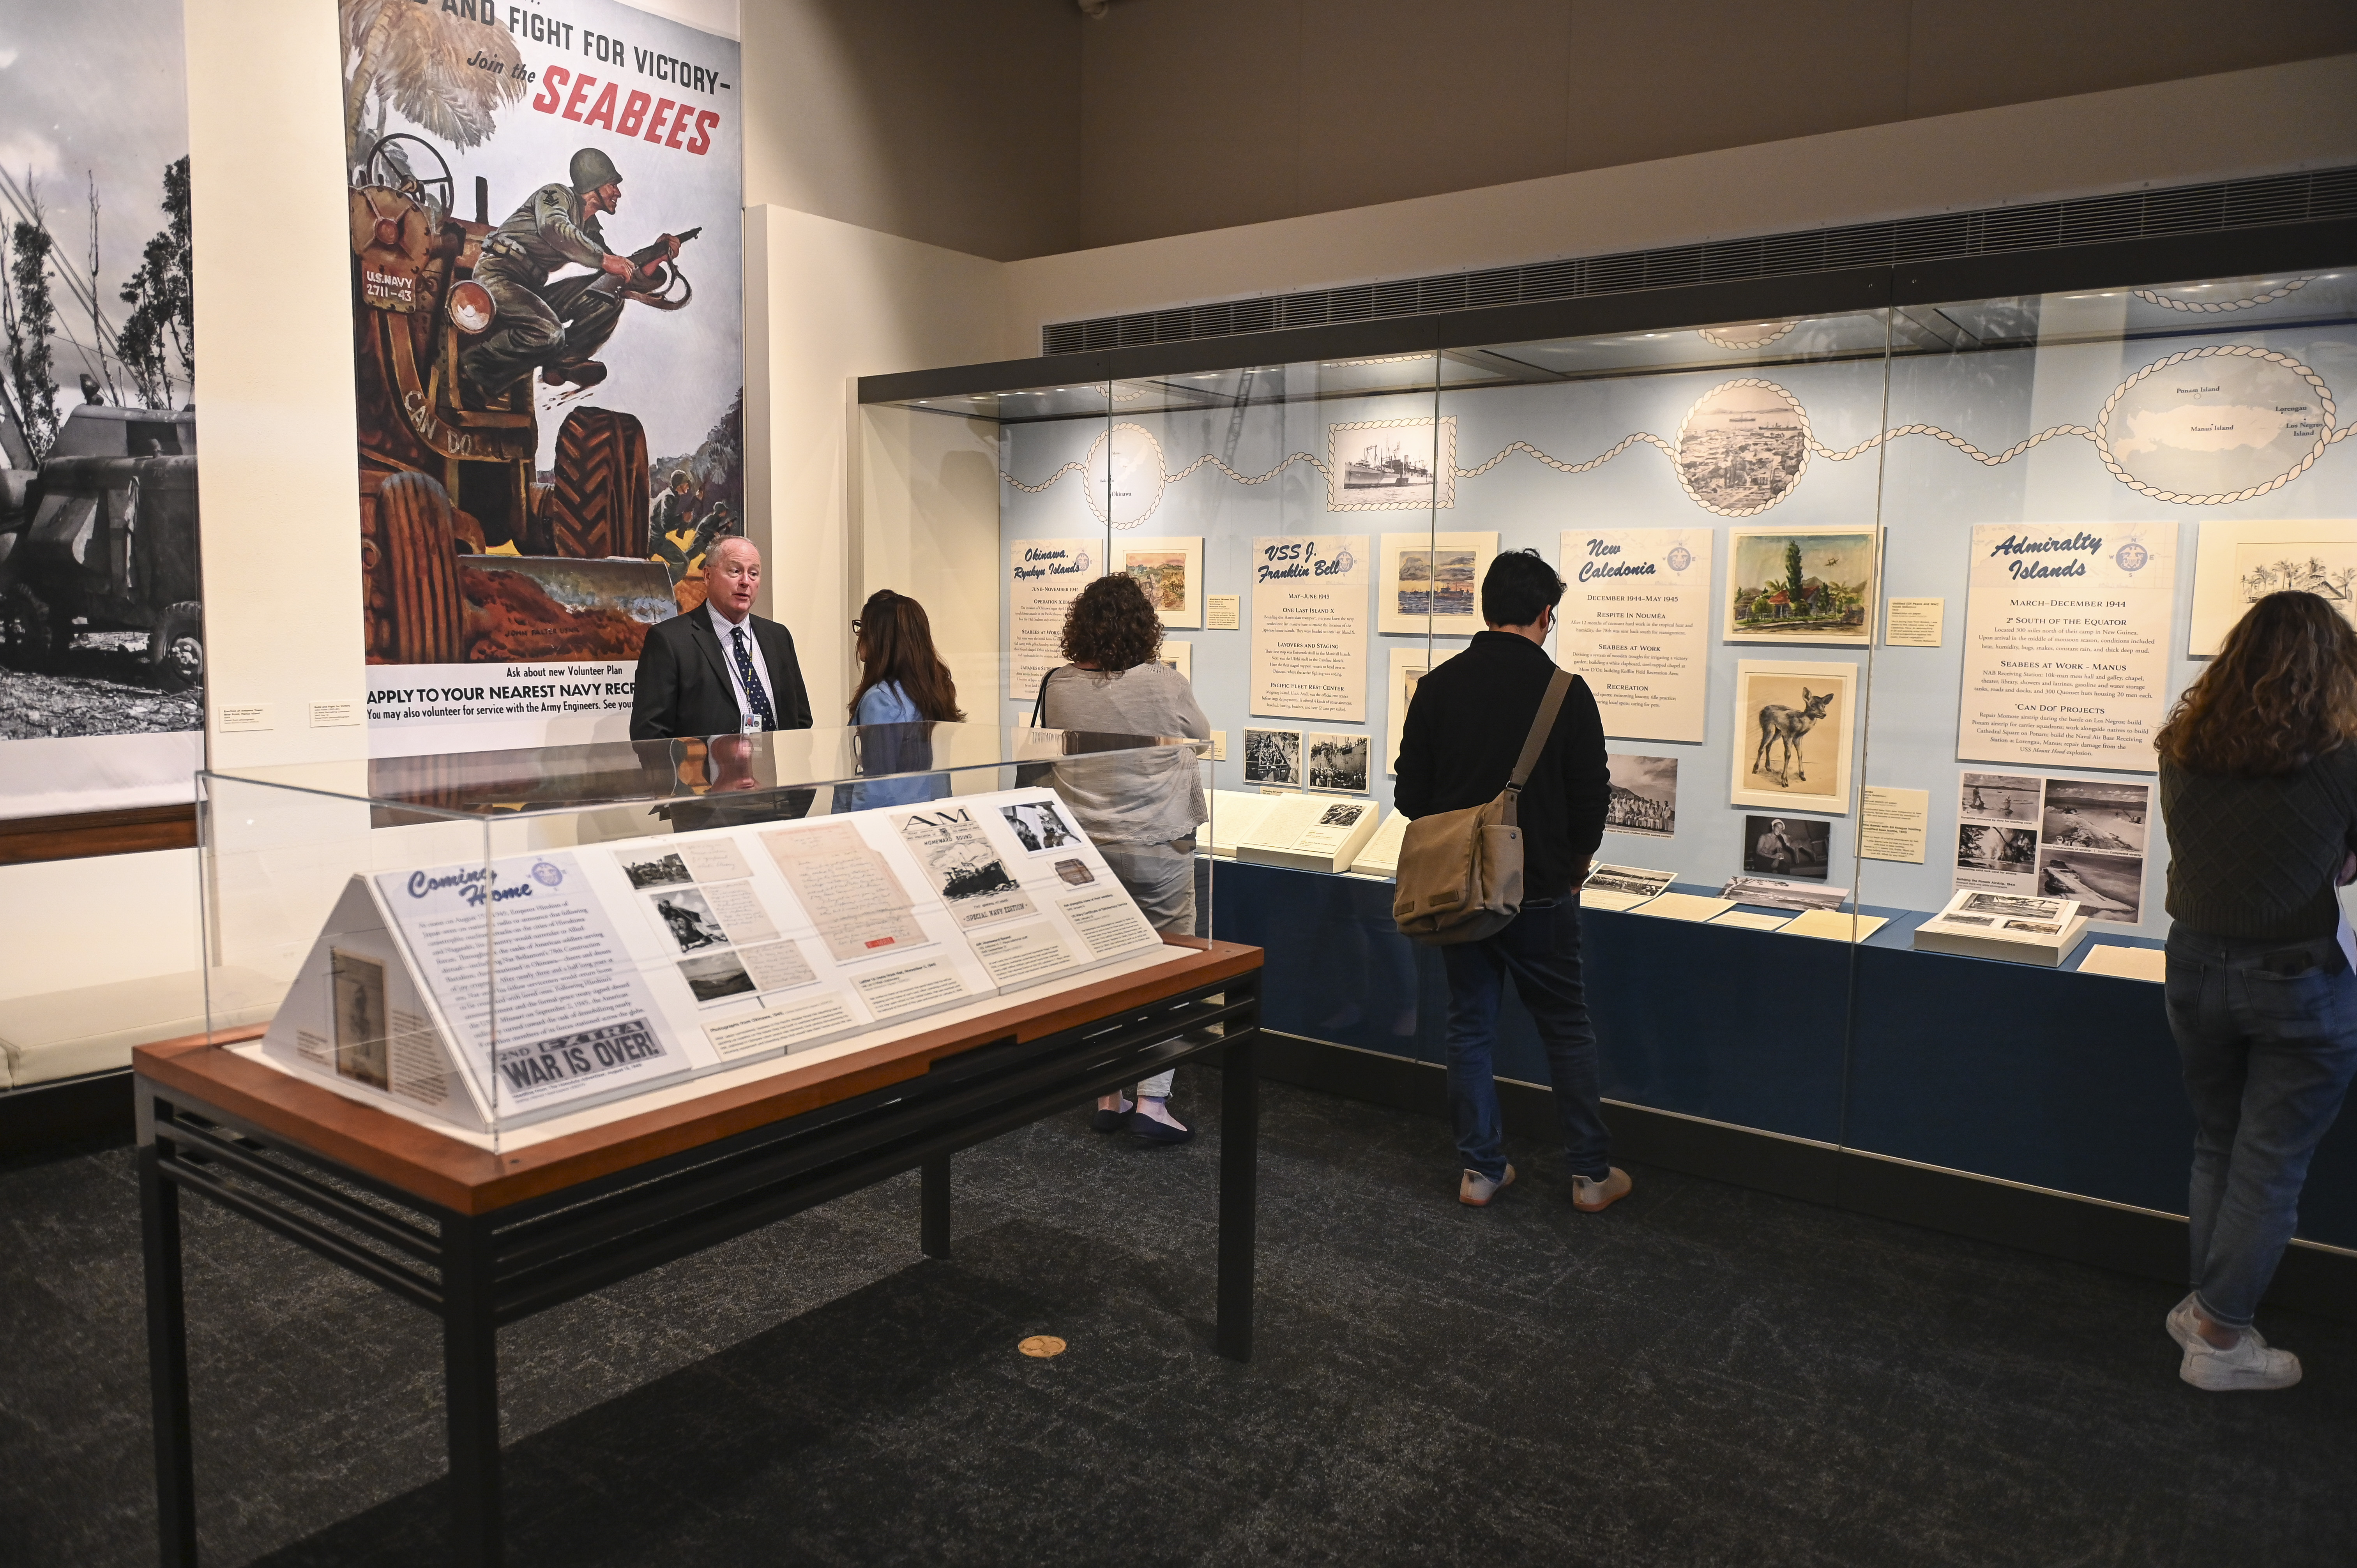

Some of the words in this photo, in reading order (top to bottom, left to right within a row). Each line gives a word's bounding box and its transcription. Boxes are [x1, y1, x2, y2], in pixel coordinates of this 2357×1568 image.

[508, 6, 573, 52] FIGHT
[584, 30, 624, 67] FOR
[467, 51, 504, 75] Join
[511, 63, 535, 85] the
[532, 64, 719, 157] SEABEES
[1306, 542, 1316, 563] J.
[1587, 539, 1620, 557] New
[1990, 532, 2102, 557] Admiralty
[1014, 565, 1045, 581] Ryukyu
[1049, 562, 1080, 575] Islands
[1258, 563, 1309, 583] Franklin
[1314, 560, 1339, 576] Bell
[1579, 561, 1656, 582] Caledonia
[2009, 558, 2086, 580] Islands
[507, 667, 520, 677] Ask
[524, 667, 546, 677] about
[568, 666, 604, 675] Volunteer
[607, 665, 622, 675] Plan
[367, 690, 414, 704] APPLY
[417, 689, 439, 702] TO
[441, 687, 484, 701] YOUR
[489, 685, 555, 699] NEAREST
[560, 683, 601, 696] NAVY
[367, 709, 380, 719] You
[383, 712, 401, 720] may
[404, 707, 420, 718] also
[422, 706, 460, 717] volunteer
[463, 705, 474, 715] for
[477, 704, 504, 715] service
[506, 703, 524, 713] with
[526, 702, 539, 712] the
[541, 702, 561, 713] Army
[564, 701, 601, 712] Engineers.
[603, 699, 616, 709] See
[966, 913, 988, 922] SPECIAL
[1004, 903, 1024, 913] EDITION
[537, 1020, 645, 1053] EXTRA
[500, 1054, 563, 1089] WAR
[562, 1048, 591, 1075] IS
[592, 1031, 659, 1067] OVER!
